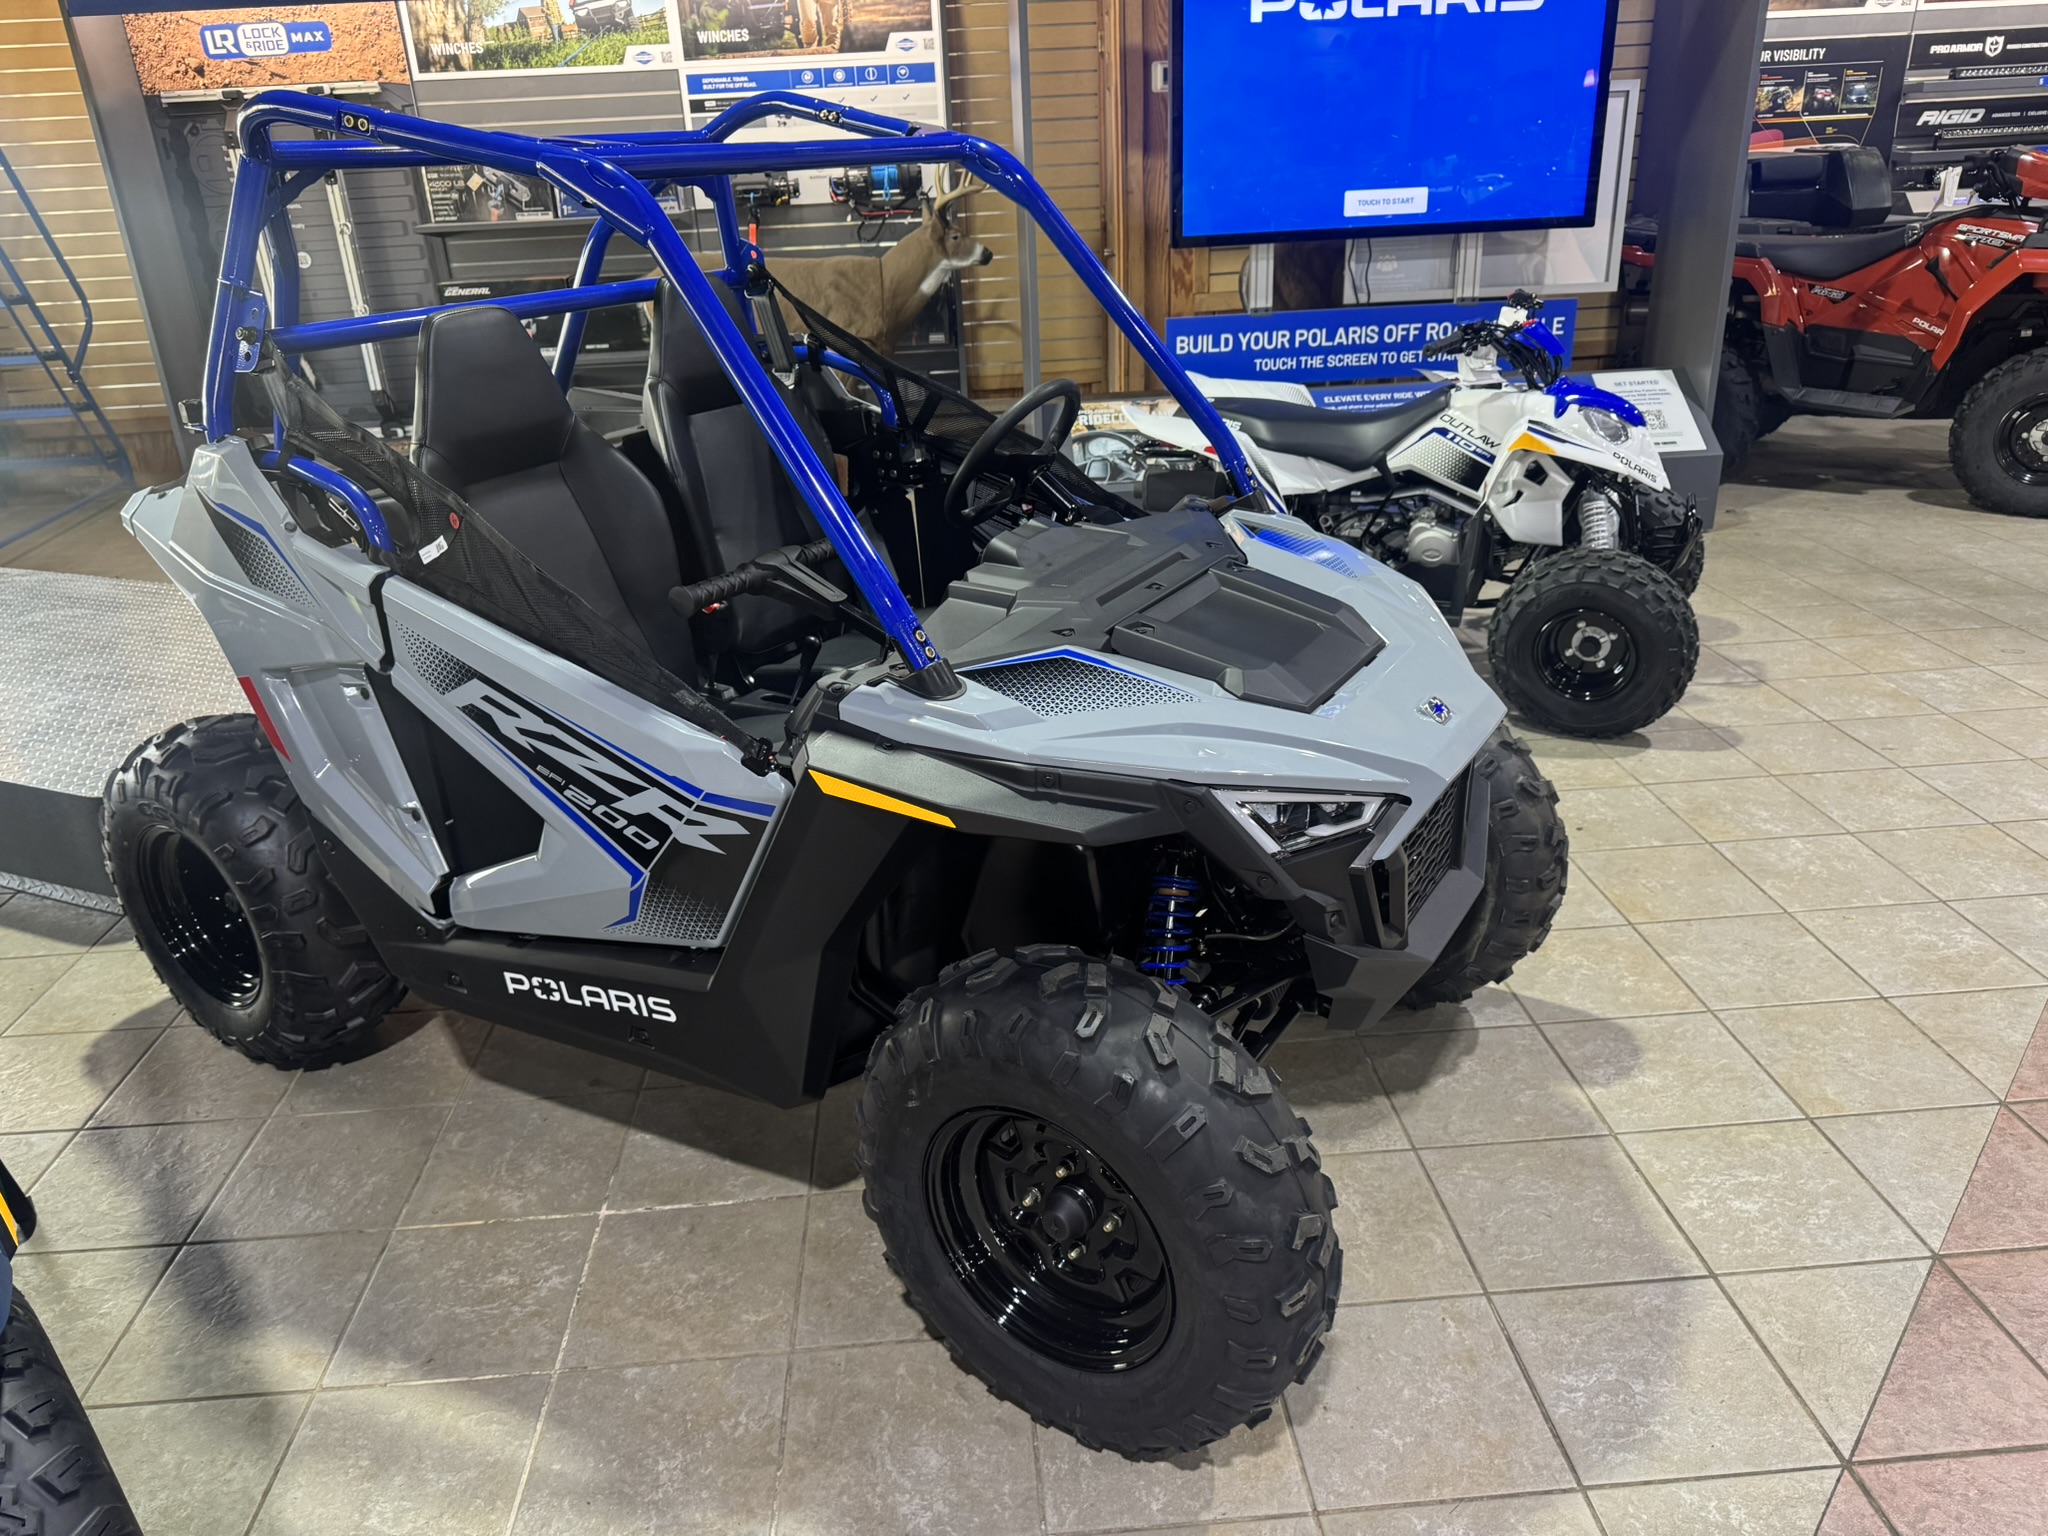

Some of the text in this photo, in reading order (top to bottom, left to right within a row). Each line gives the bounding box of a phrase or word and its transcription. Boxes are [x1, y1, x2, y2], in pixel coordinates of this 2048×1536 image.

[242, 27, 282, 39] LOCK
[291, 31, 325, 43] MAX
[696, 29, 750, 44] WINCHES
[430, 41, 484, 56] WINCHES
[1774, 48, 1826, 62] VISIBILITY
[1916, 108, 1986, 126] RIGID
[1392, 197, 1415, 205] START
[1956, 223, 2027, 242] SPORTSMA
[444, 286, 491, 297] GENERAL
[1912, 317, 1945, 337] POLAR
[1176, 321, 1458, 355] BUILD YOUR POLARIS OFF RO
[1254, 357, 1296, 371] TOUCH
[1299, 355, 1324, 369] THE
[1327, 352, 1378, 368] SCREEN
[1380, 350, 1397, 365] TO
[1400, 349, 1423, 364] GET
[1324, 394, 1362, 404] ELEVATE
[1364, 392, 1392, 402] EVERY
[1393, 391, 1413, 400] RIDE
[1439, 413, 1501, 448] OUTLAW
[1445, 431, 1477, 452] 110
[1612, 451, 1657, 484] POLARIS
[449, 677, 751, 856] RZR
[535, 764, 661, 851] EFI 200
[502, 970, 678, 1024] POLARIS
